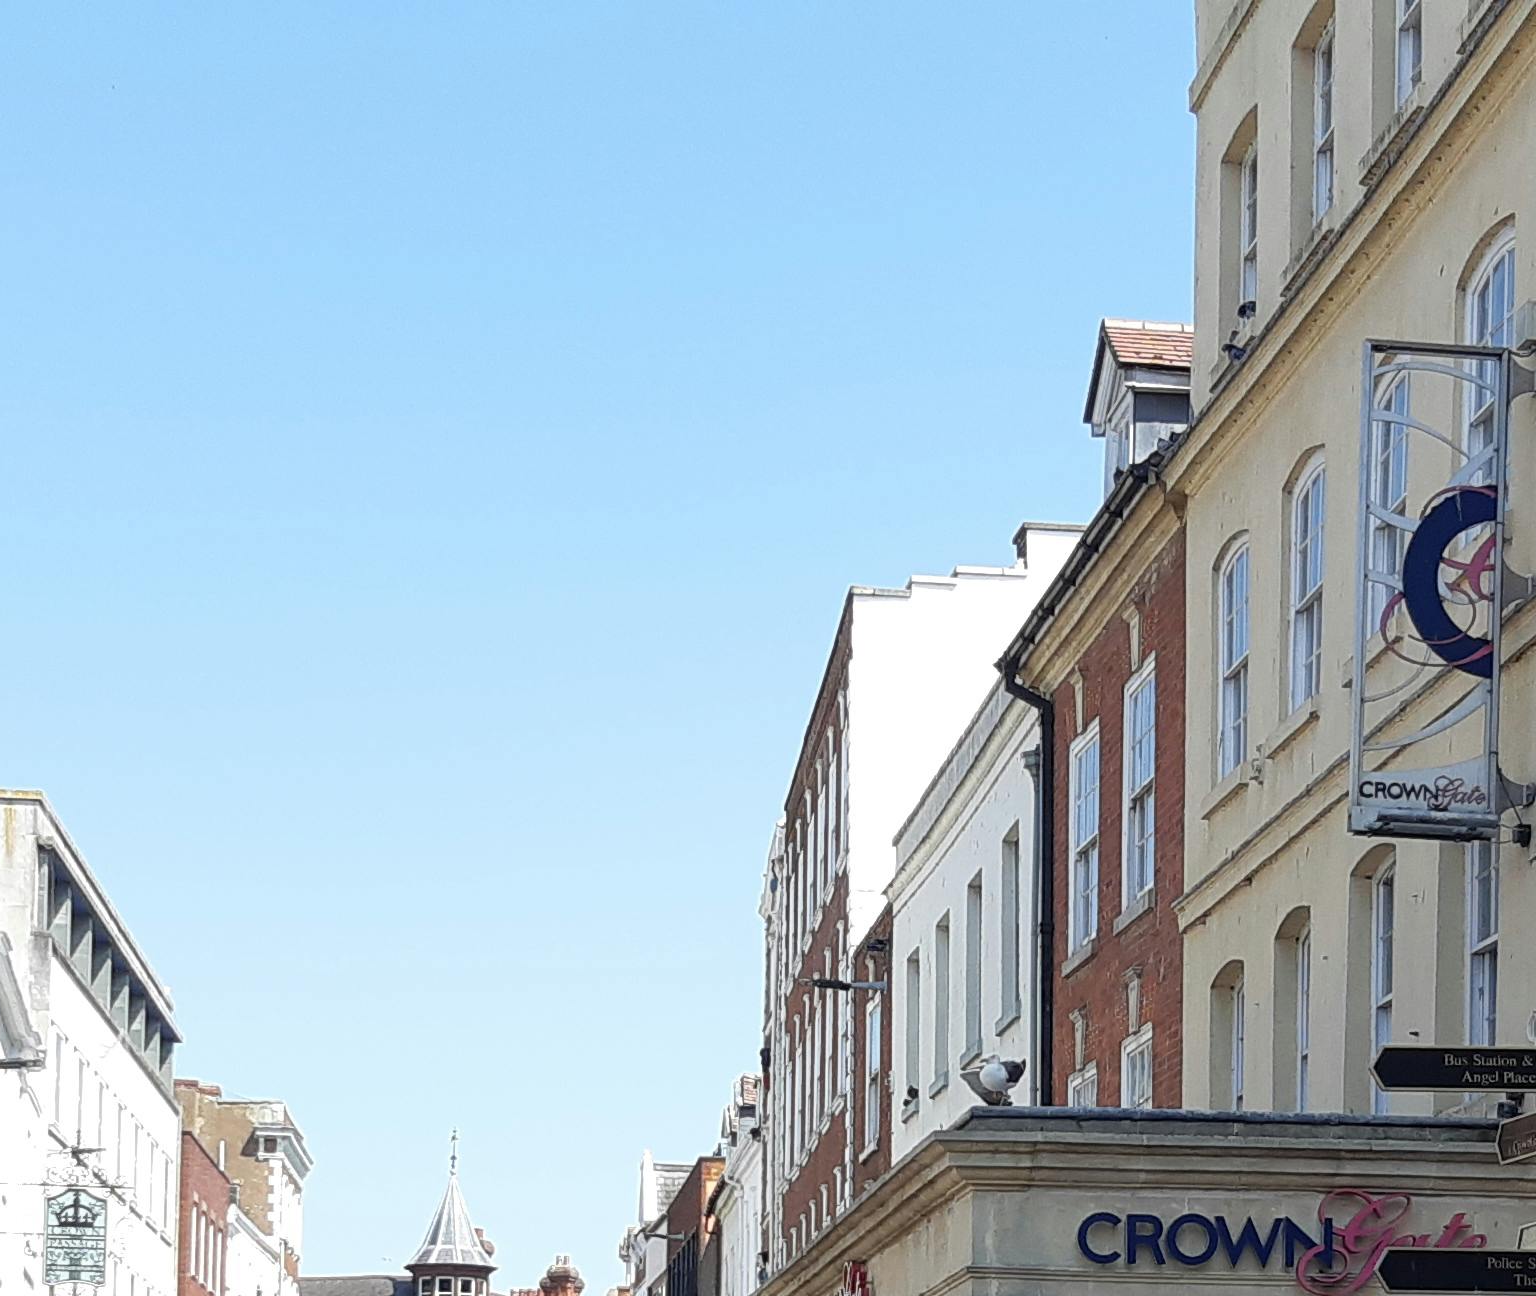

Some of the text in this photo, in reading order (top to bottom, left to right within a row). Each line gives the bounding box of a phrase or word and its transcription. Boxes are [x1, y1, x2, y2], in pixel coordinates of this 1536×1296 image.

[1444, 1054, 1468, 1066] Bus
[1473, 1054, 1517, 1066] Station
[1522, 1055, 1534, 1066] &
[1462, 1071, 1499, 1086] Angel
[1504, 1072, 1536, 1084] Place
[1487, 1256, 1523, 1270] Police
